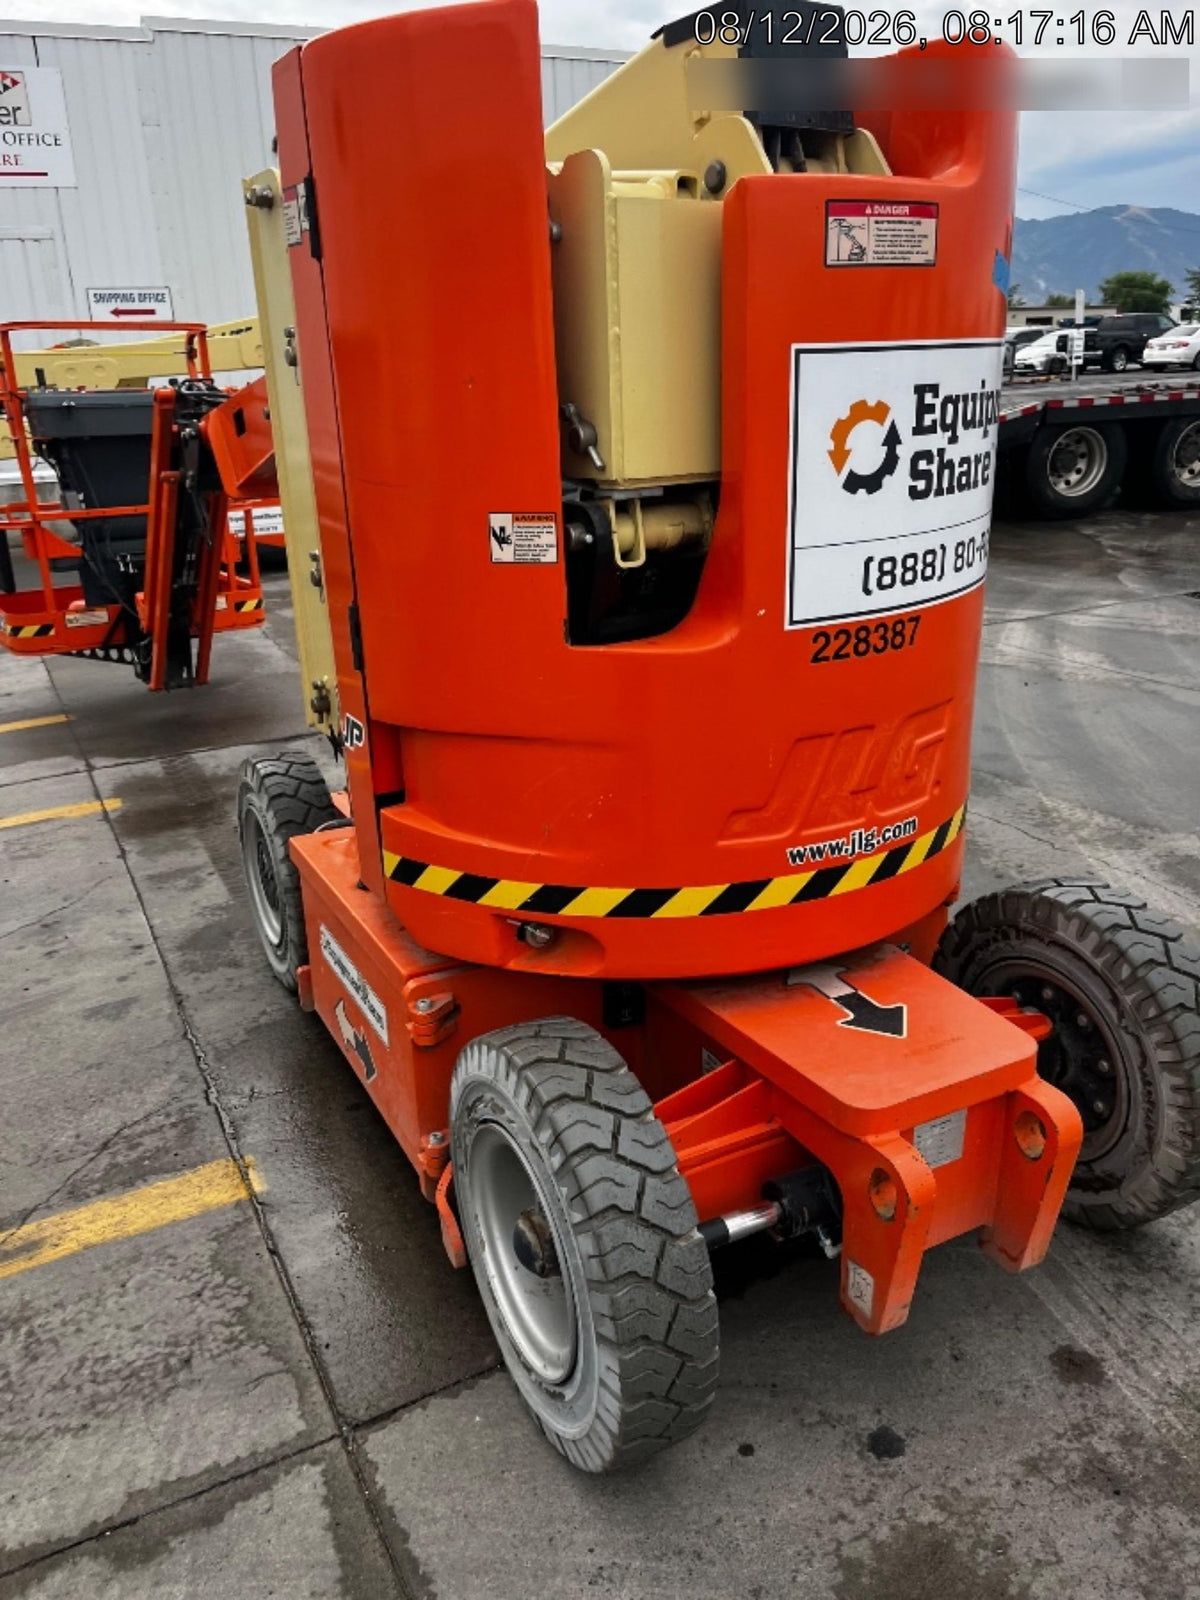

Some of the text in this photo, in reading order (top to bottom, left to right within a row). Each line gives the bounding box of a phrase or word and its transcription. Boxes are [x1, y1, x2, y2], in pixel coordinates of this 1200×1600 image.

[3, 131, 62, 147] OFFICE
[0, 153, 23, 167] RE
[873, 205, 910, 216] DANGER
[93, 293, 167, 304] SHIPPING OFFICE
[908, 447, 990, 501] Share
[861, 543, 946, 596] (888)
[810, 614, 921, 663] 228387
[787, 815, 918, 865] www.jlg.com
